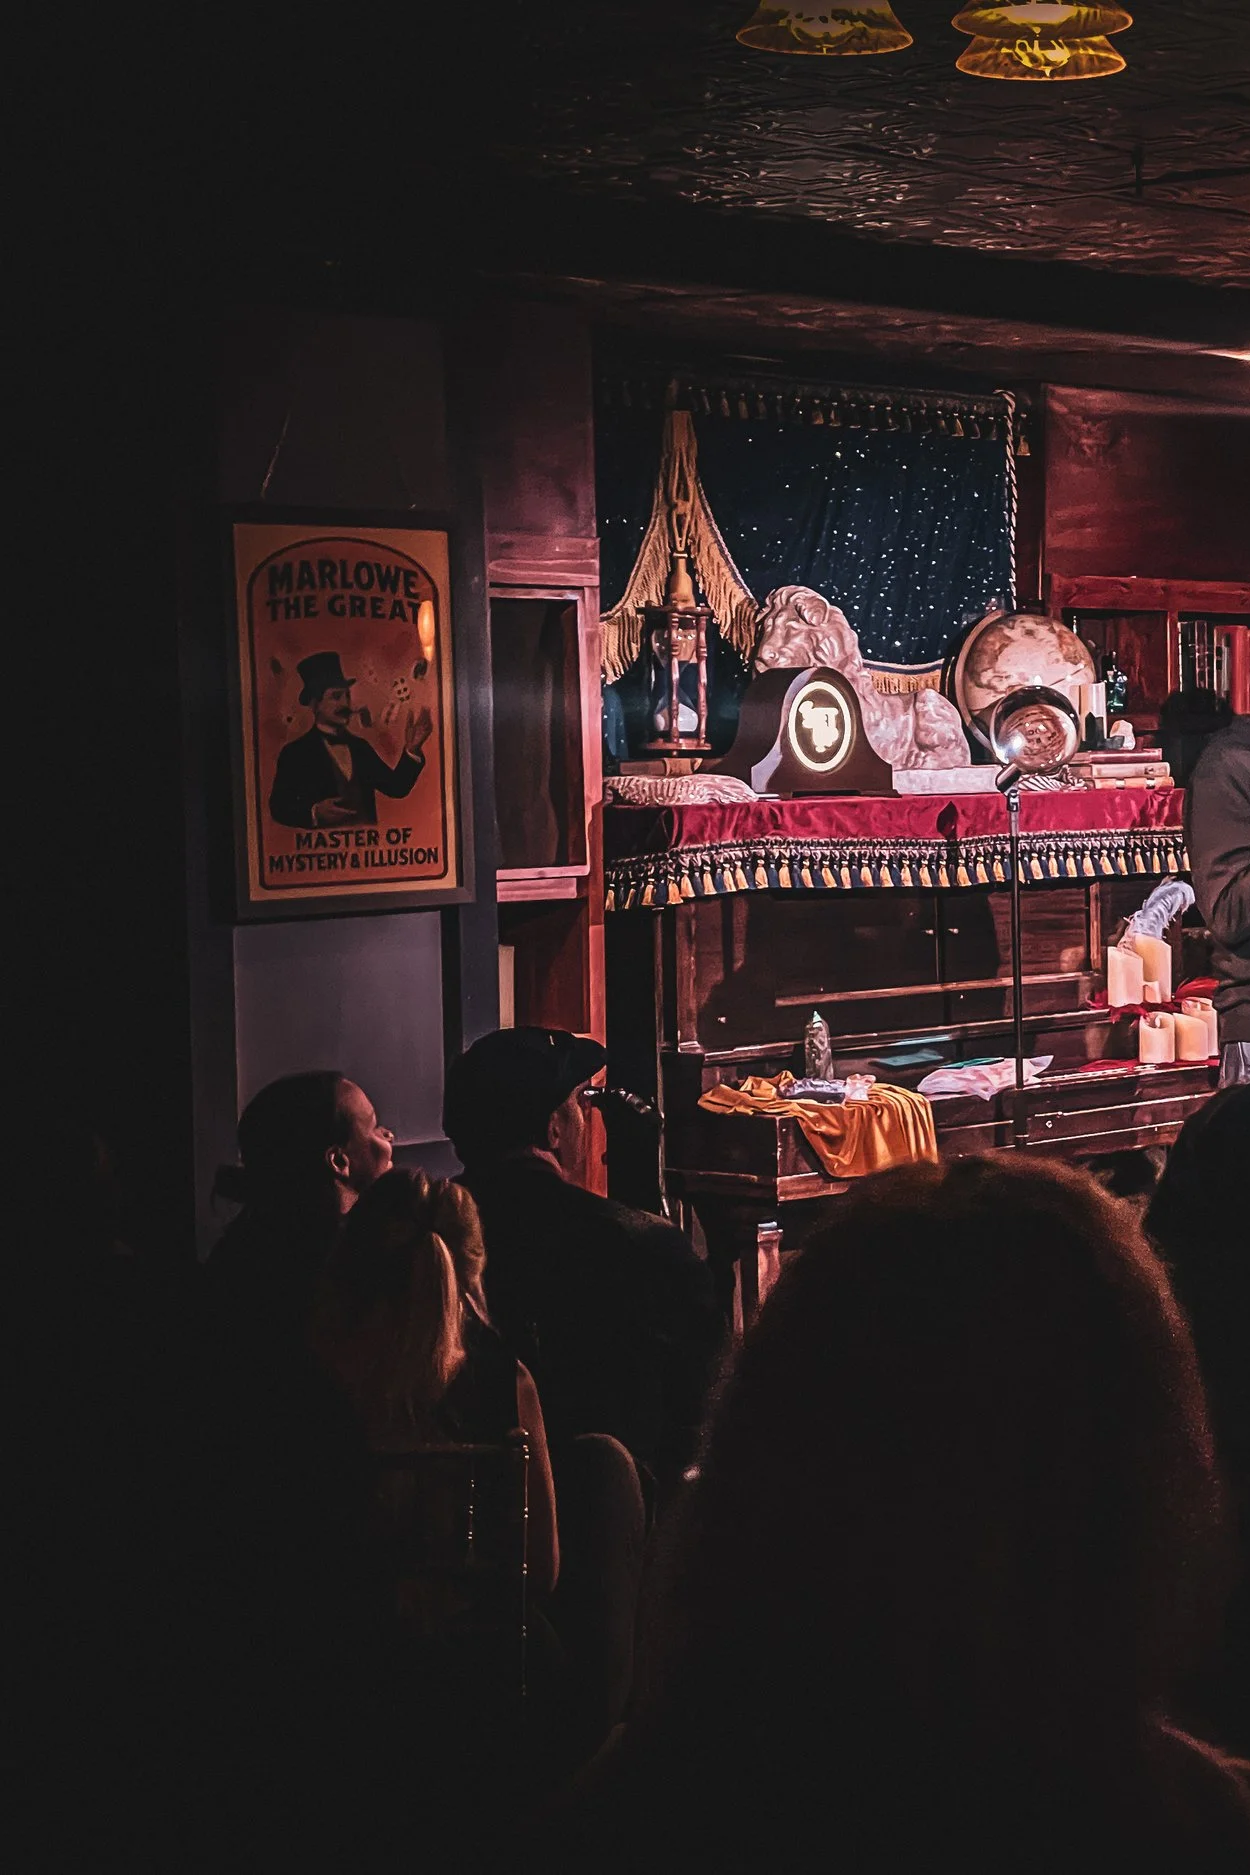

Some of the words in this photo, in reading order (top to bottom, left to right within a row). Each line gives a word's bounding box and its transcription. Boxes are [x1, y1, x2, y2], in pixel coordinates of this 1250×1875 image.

[268, 559, 419, 598] MARLOWE
[266, 595, 318, 621] THE
[328, 594, 421, 624] GREAT
[297, 829, 379, 850] MASTER
[387, 828, 413, 845] OF
[269, 851, 348, 873] MYSTERY
[351, 853, 360, 868] &
[364, 846, 439, 868] ILLUSION
